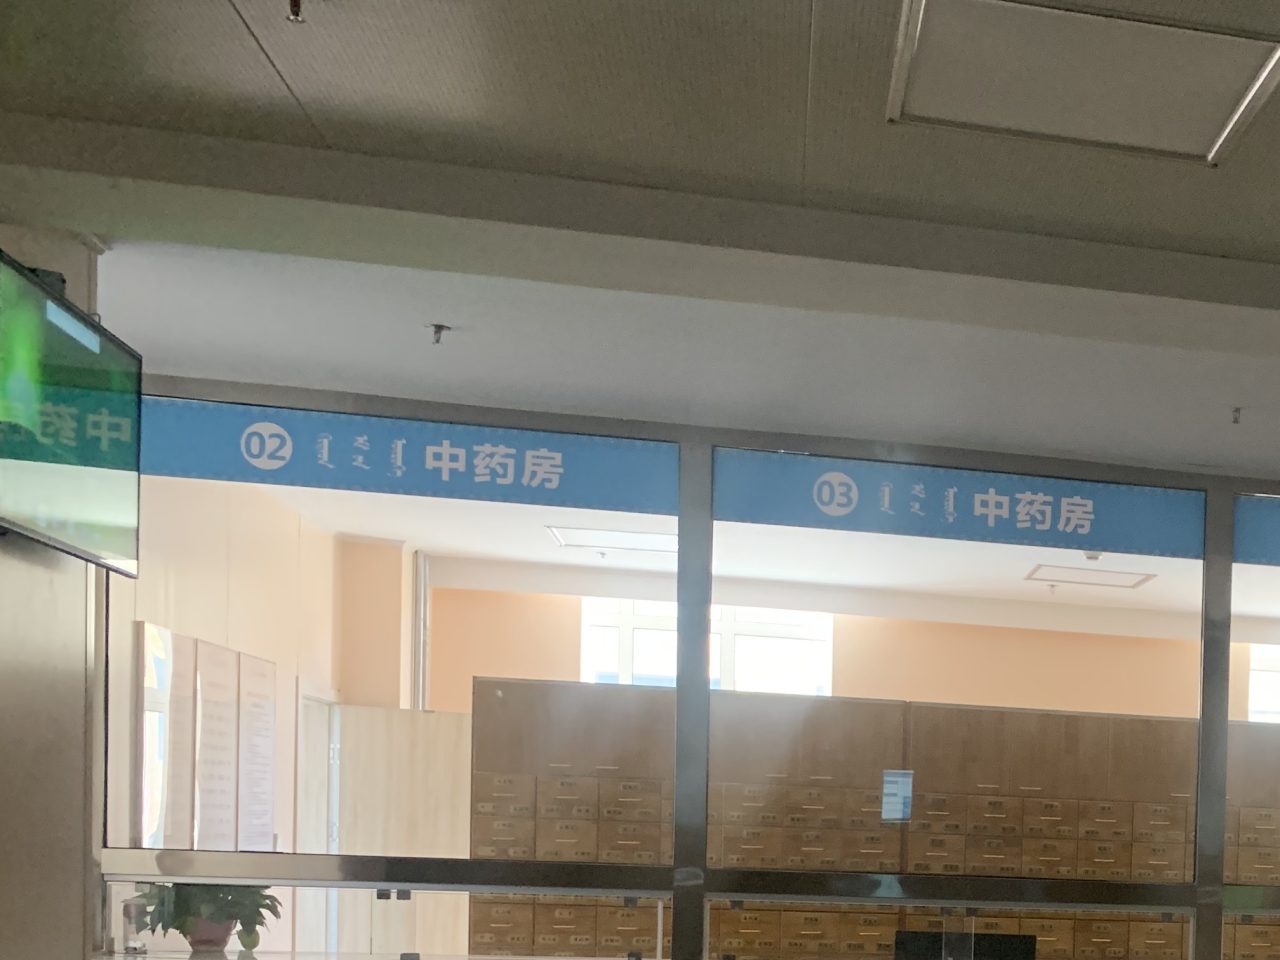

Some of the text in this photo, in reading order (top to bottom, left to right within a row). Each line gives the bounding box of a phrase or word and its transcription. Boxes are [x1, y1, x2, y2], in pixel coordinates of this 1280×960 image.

[243, 428, 289, 463] 02
[424, 439, 565, 490] 中药房
[815, 478, 856, 510] 03
[973, 488, 1095, 535] 中药房
